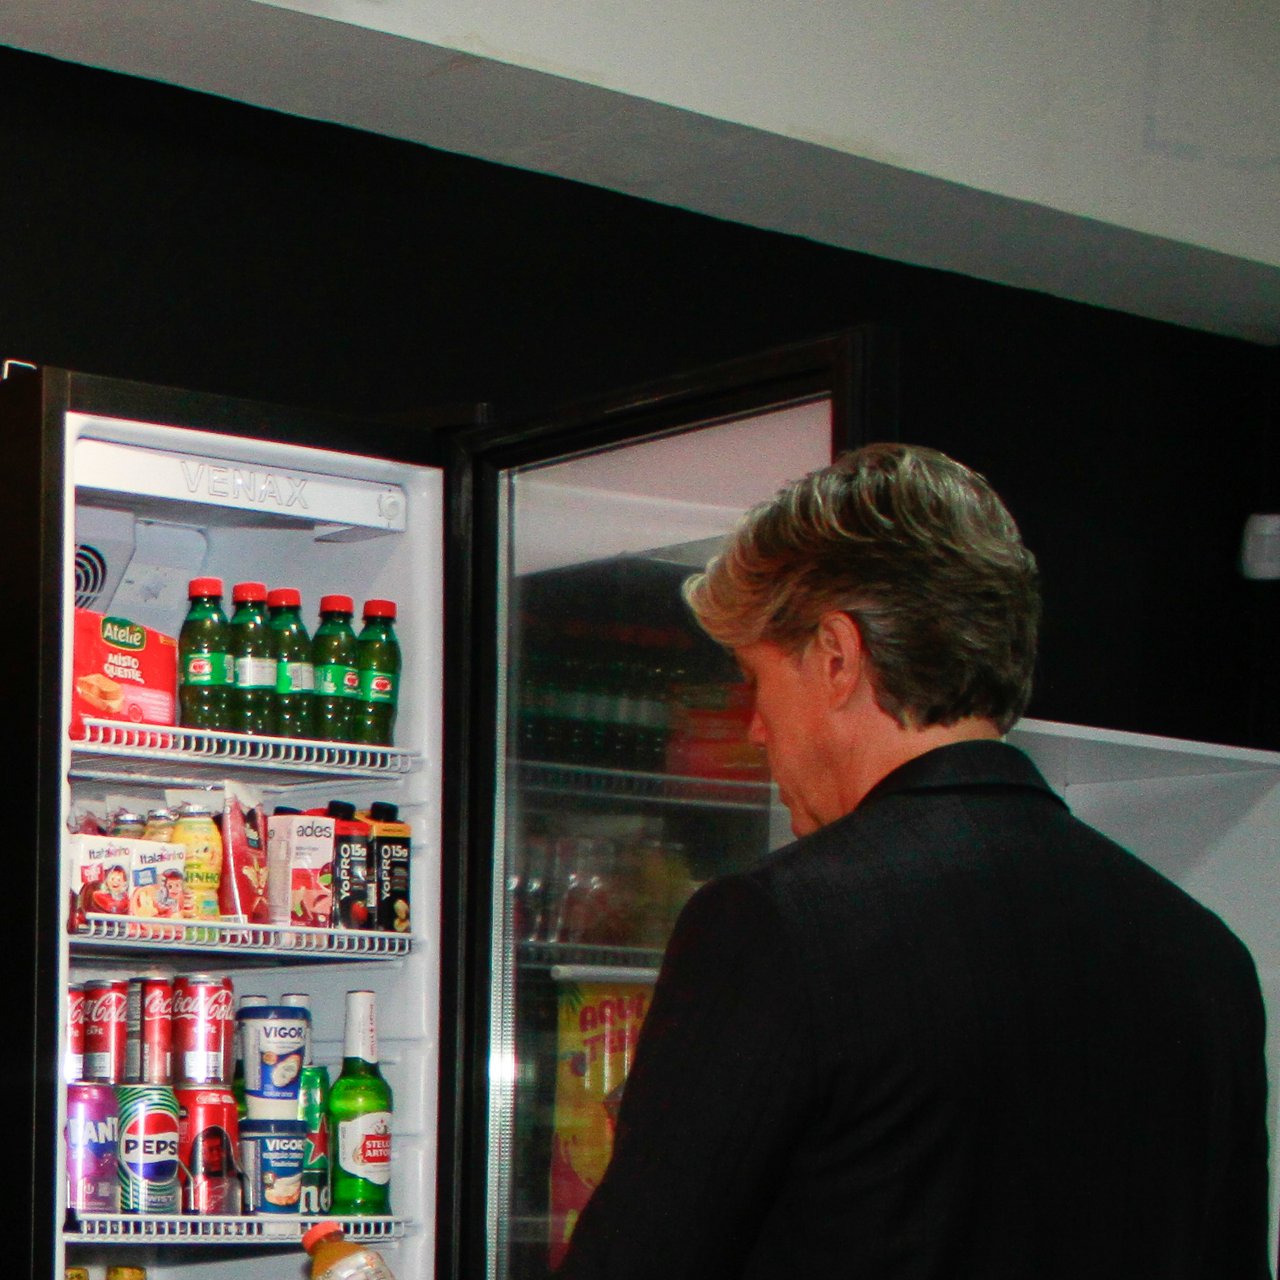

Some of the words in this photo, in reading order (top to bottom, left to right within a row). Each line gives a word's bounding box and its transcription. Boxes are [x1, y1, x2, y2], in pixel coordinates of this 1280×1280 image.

[179, 459, 310, 510] VENAX
[296, 822, 333, 840] ades
[263, 1026, 304, 1039] VIGOR
